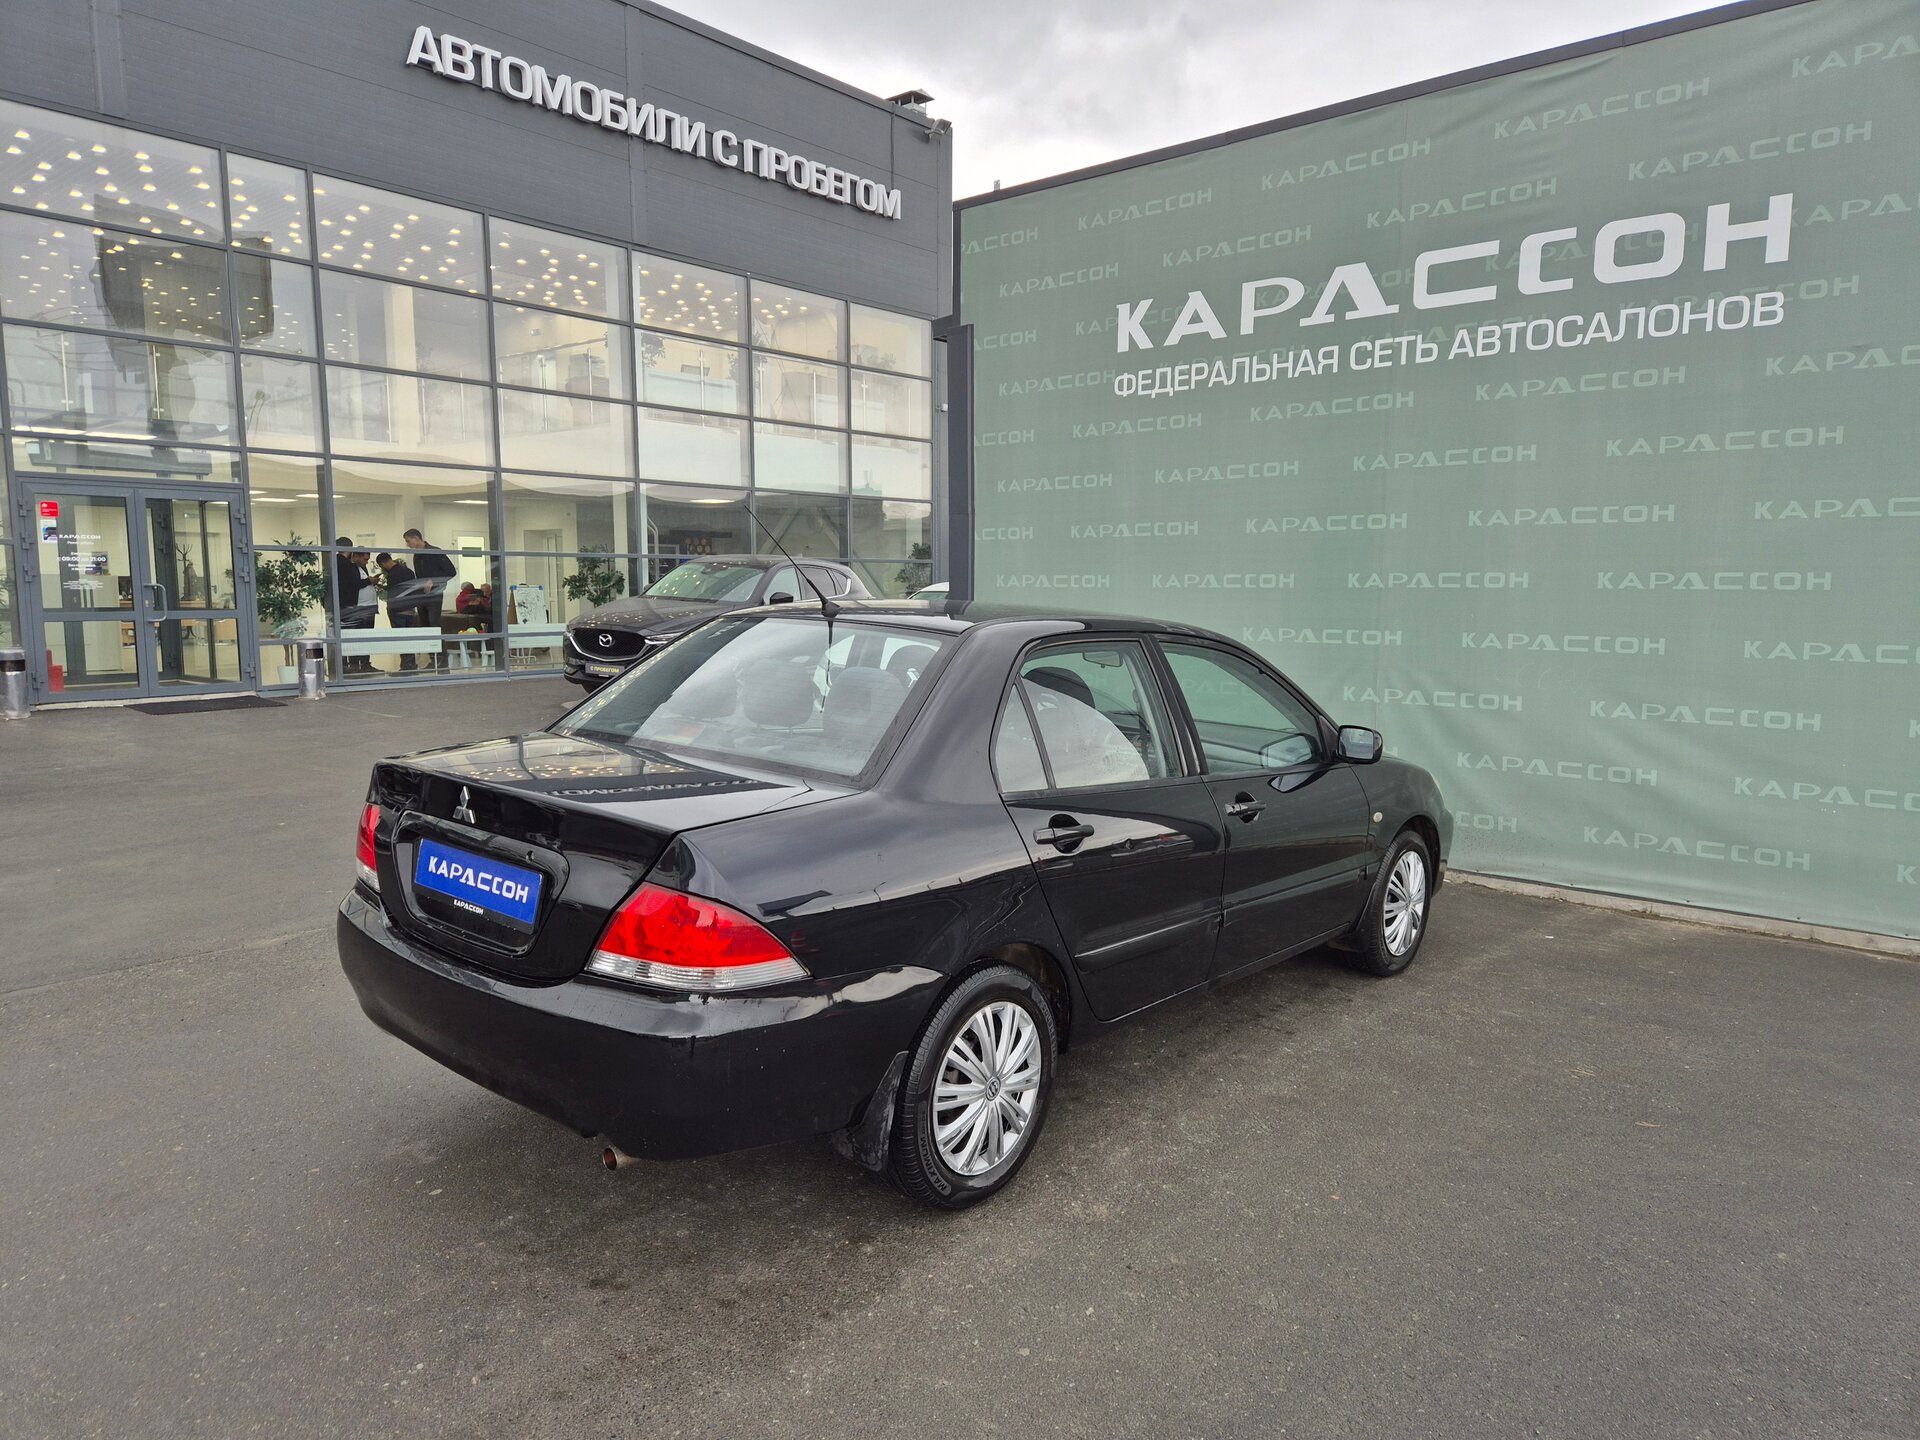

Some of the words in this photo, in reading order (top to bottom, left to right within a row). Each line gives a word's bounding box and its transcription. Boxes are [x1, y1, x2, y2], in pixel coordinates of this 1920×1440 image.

[406, 25, 706, 158] АВТОМОБИЛИ
[712, 129, 738, 168] С
[743, 138, 901, 220] ПРОБЕГОМ
[1493, 76, 1710, 140] КАРАССОН
[1260, 136, 1430, 191] КАРАССОН
[1627, 119, 1873, 181] КАРАССОН
[1078, 187, 1212, 231] КАРАССОН
[1367, 176, 1557, 229] КАРАССОН
[1162, 224, 1313, 268] КАРАССОН
[1000, 262, 1119, 298] КАРАССОН
[1113, 193, 1793, 353] КАРАССОН
[1114, 345, 1339, 398] ФЕДЕРАЛЬНАЯ
[1349, 334, 1439, 371] СЕТЬ
[1448, 291, 1785, 360] АВТОСАЛОНОВ
[999, 369, 1116, 396] КАРАССОН
[1476, 365, 1686, 401] КАРАССОН
[1250, 391, 1414, 422] КАРАССОН
[1072, 413, 1202, 438] КАРАССОН
[1606, 425, 1844, 457] КАРАССОН
[1155, 460, 1299, 484] КАРАССОН
[1353, 444, 1537, 472] КАРАССОН
[998, 473, 1112, 493] КАРАССОН
[1071, 520, 1199, 539] КАРАССОН
[1246, 513, 1408, 535] КАРАССОН
[1468, 504, 1675, 527] КАРАССОН
[996, 574, 1110, 590] КАРАССОН
[1152, 573, 1295, 590] КАРАССОН
[1347, 572, 1529, 591] КАРАССОН
[1597, 572, 1832, 591] КАРАССОН
[1243, 626, 1402, 646] КАРАССОН
[1461, 632, 1666, 656] КАРАССОН
[1343, 686, 1523, 712] КАРАССОН
[1590, 700, 1822, 732] КАРАССОН
[1456, 751, 1658, 787] КАРАССОН
[1583, 826, 1811, 871] КАРАССОН
[428, 855, 529, 903] КАРАССОН
[453, 899, 484, 915] КАРАССОН
[920, 1138, 947, 1192] MAXIMUM
